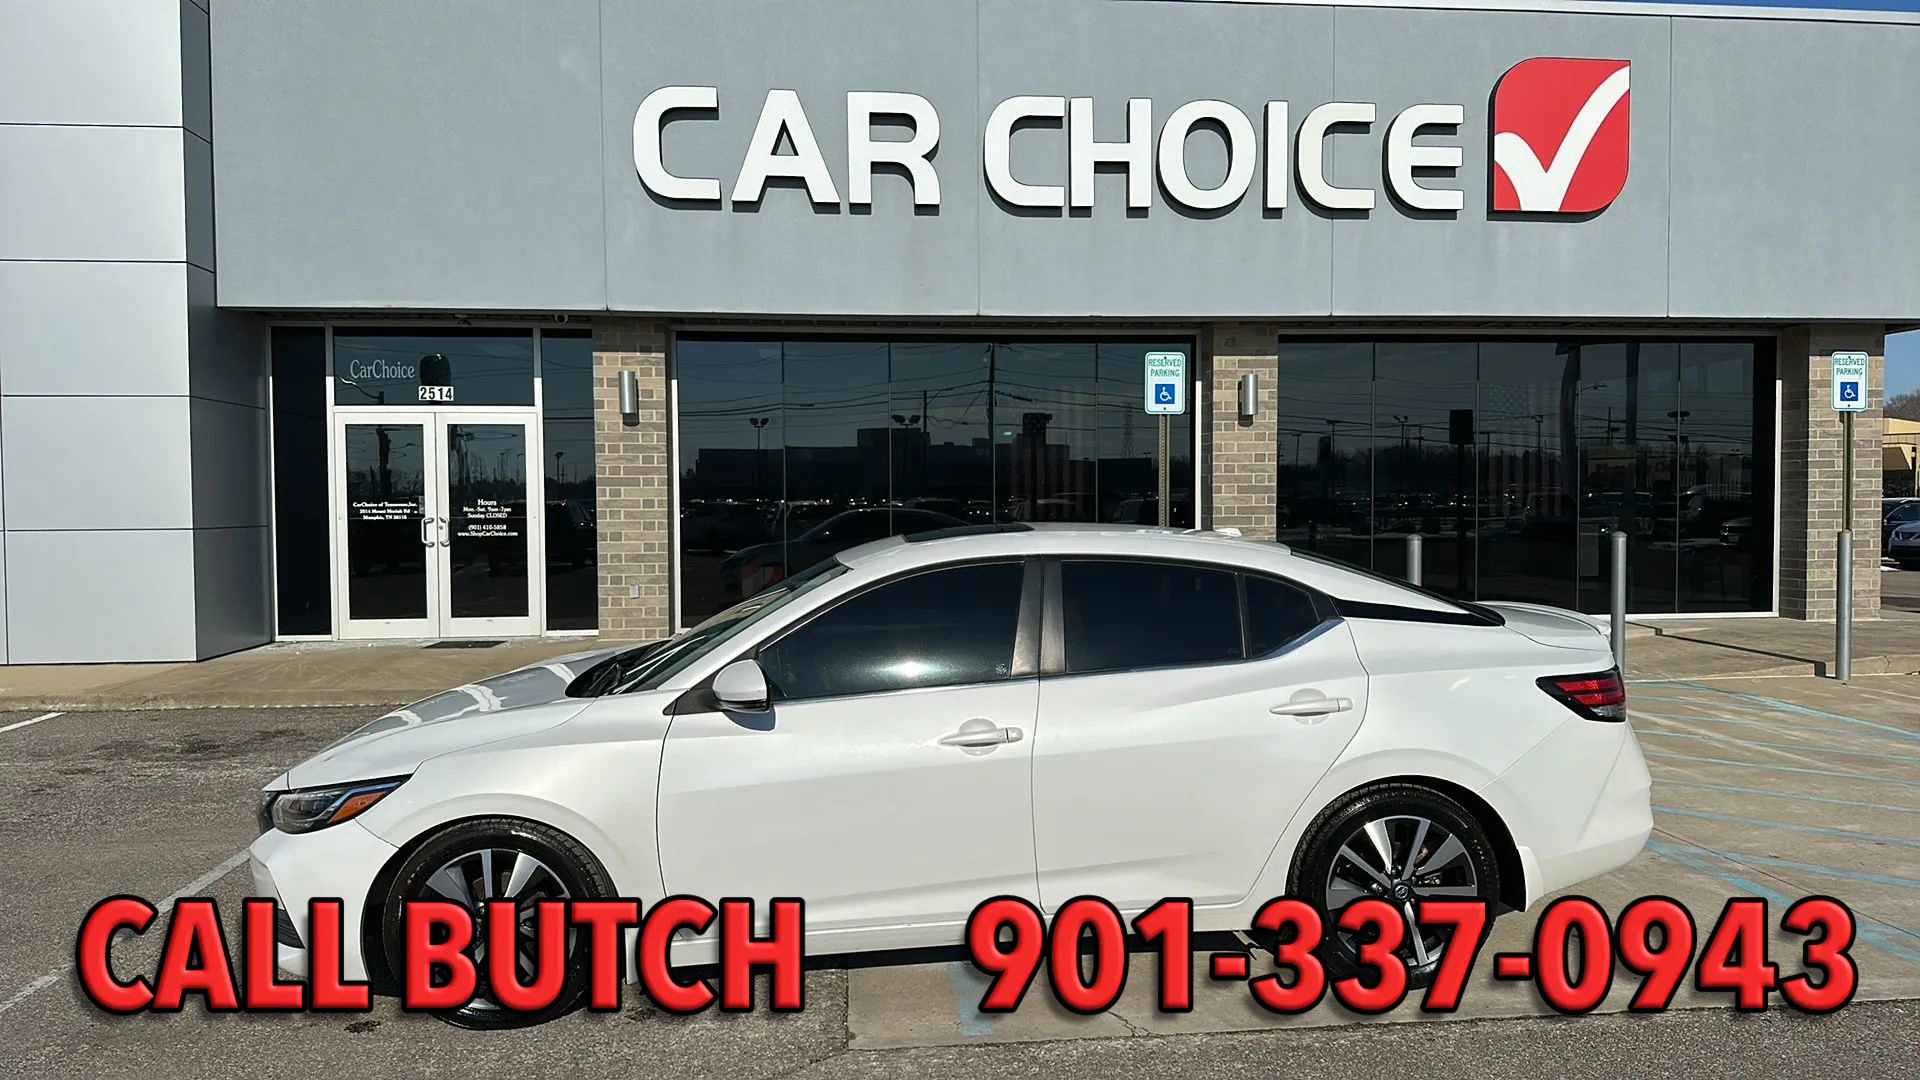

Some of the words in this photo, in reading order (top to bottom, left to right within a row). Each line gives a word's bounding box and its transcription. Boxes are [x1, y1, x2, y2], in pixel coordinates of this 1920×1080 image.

[631, 86, 942, 207] CAR
[983, 95, 1464, 211] CHOICE
[1148, 359, 1182, 367] RESERVED
[1834, 358, 1865, 366] RESERVED
[350, 359, 415, 379] CarChoice
[1150, 369, 1180, 377] PARKING
[1836, 368, 1863, 376] PARKING
[420, 387, 452, 400] 2514
